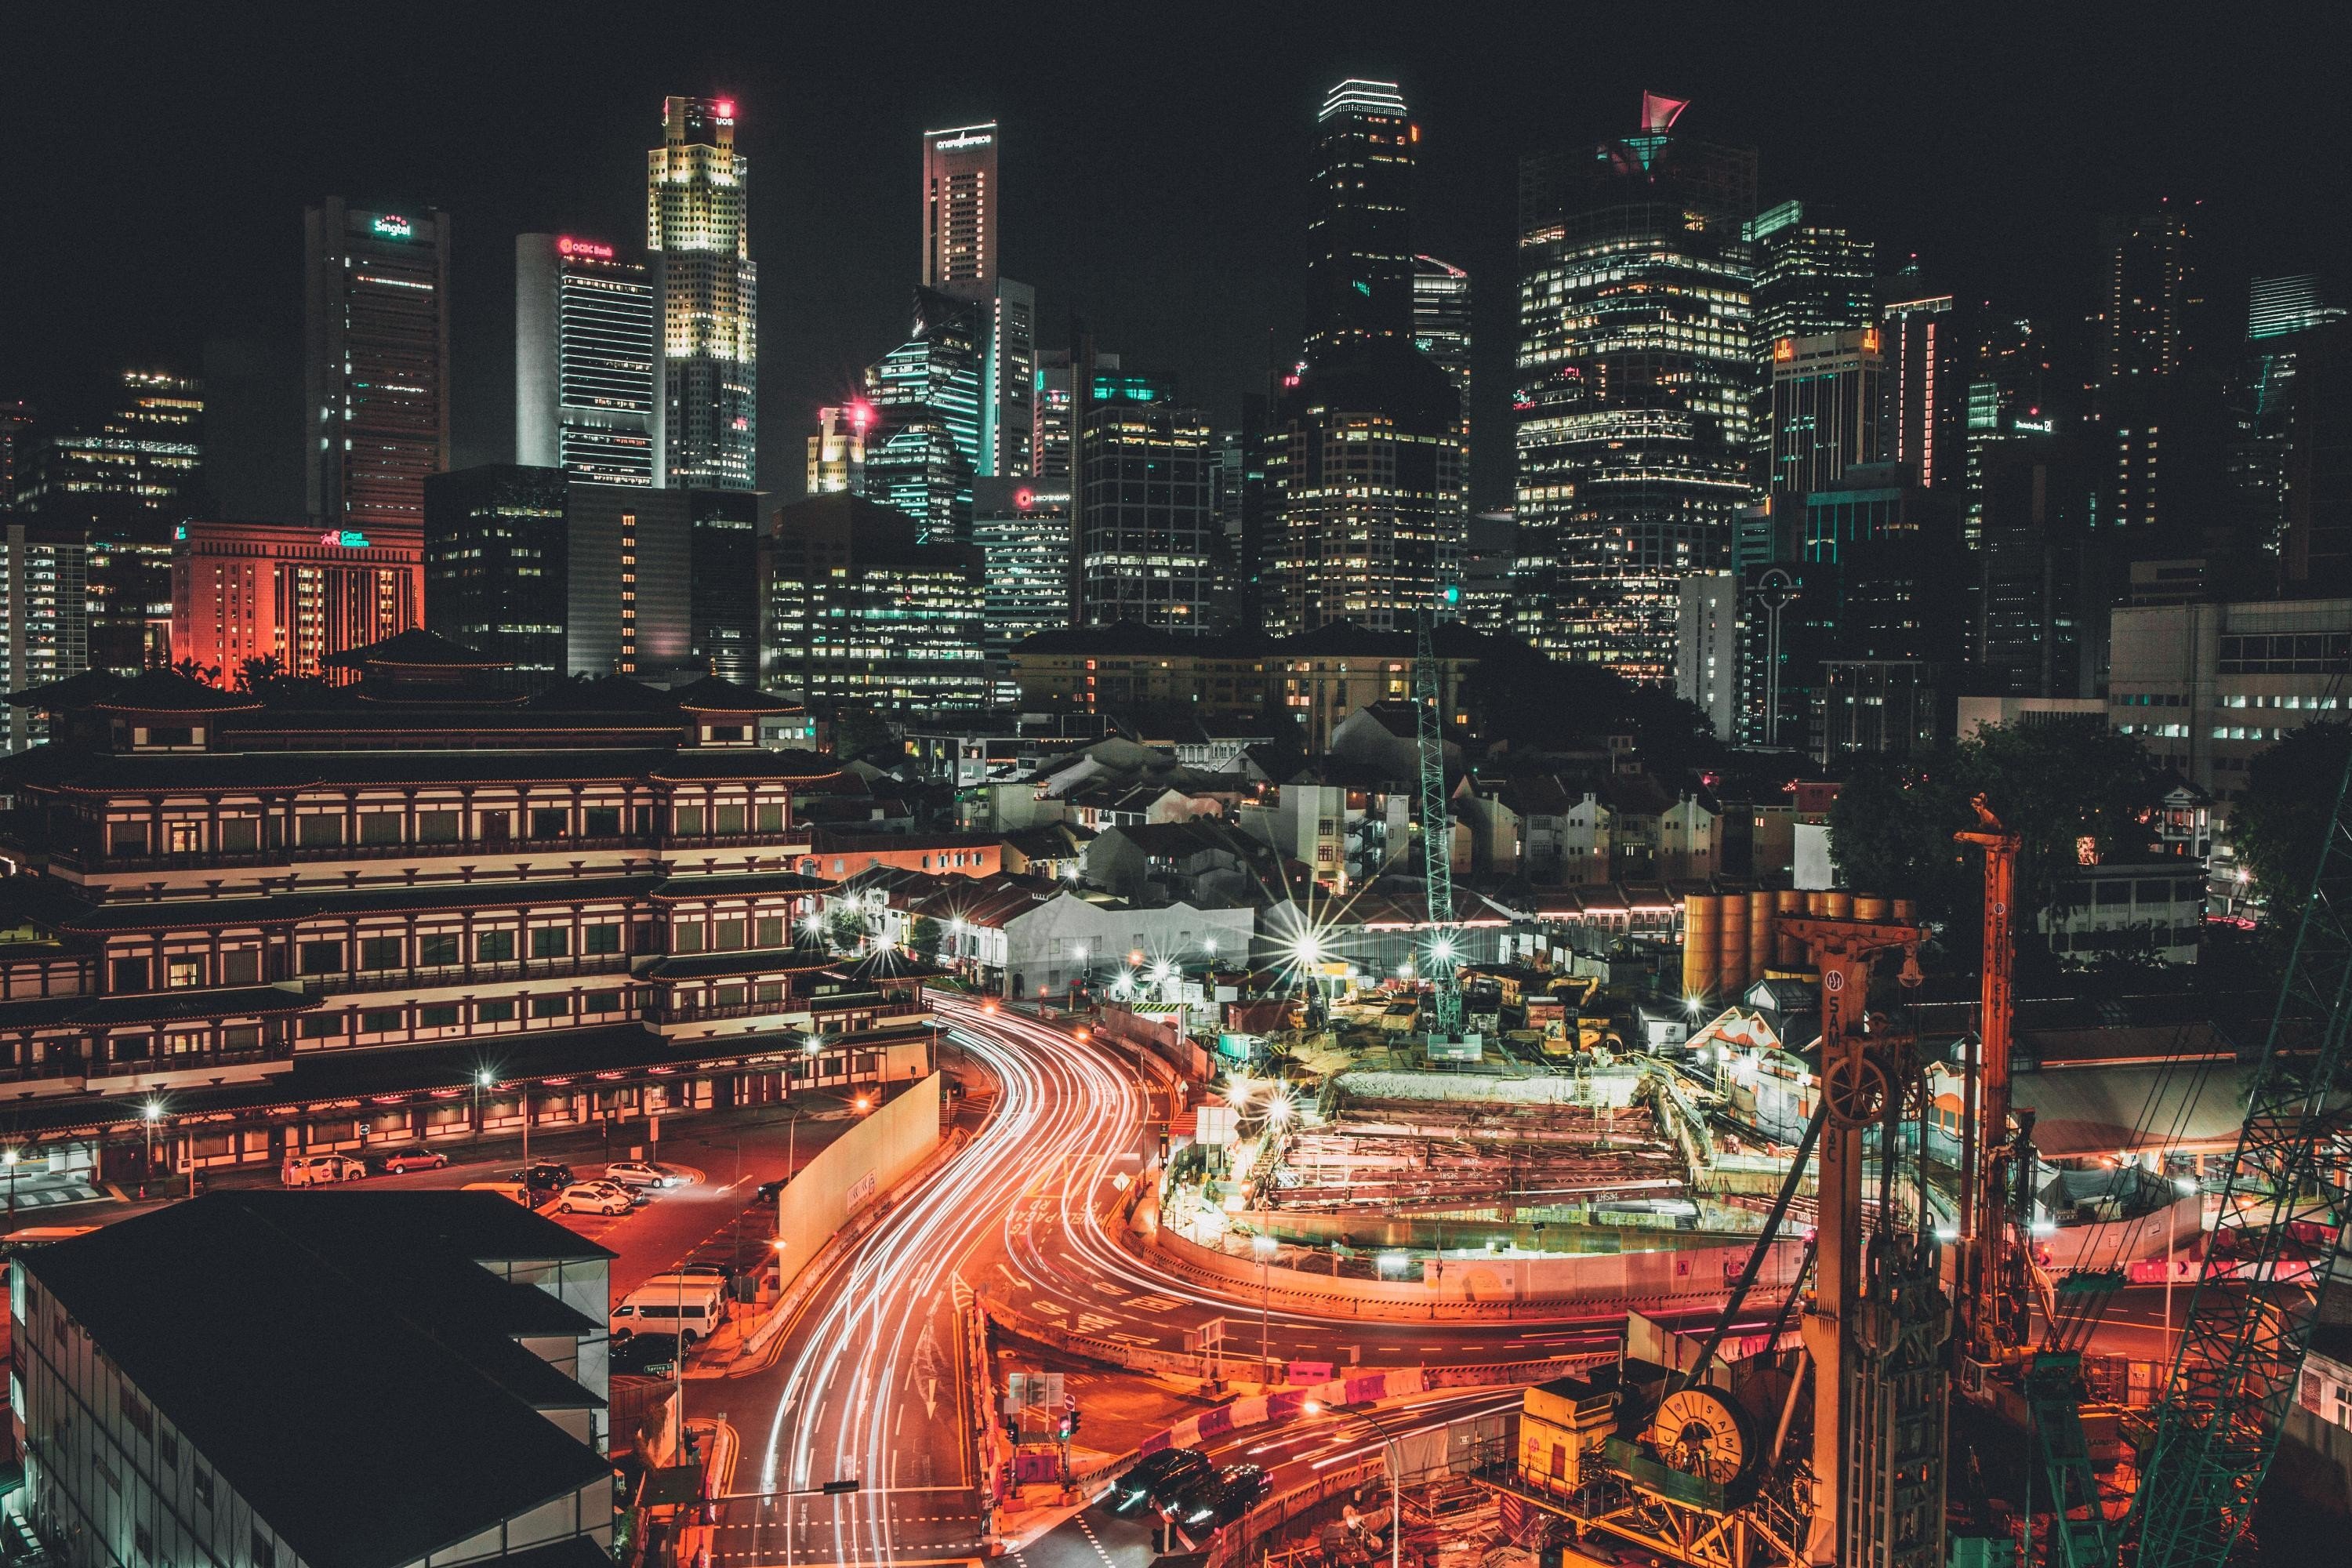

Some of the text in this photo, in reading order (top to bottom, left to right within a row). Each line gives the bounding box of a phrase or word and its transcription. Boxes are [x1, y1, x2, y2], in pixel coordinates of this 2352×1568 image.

[716, 117, 734, 125] UOB
[375, 220, 411, 236] Singtel
[341, 531, 363, 540] Great
